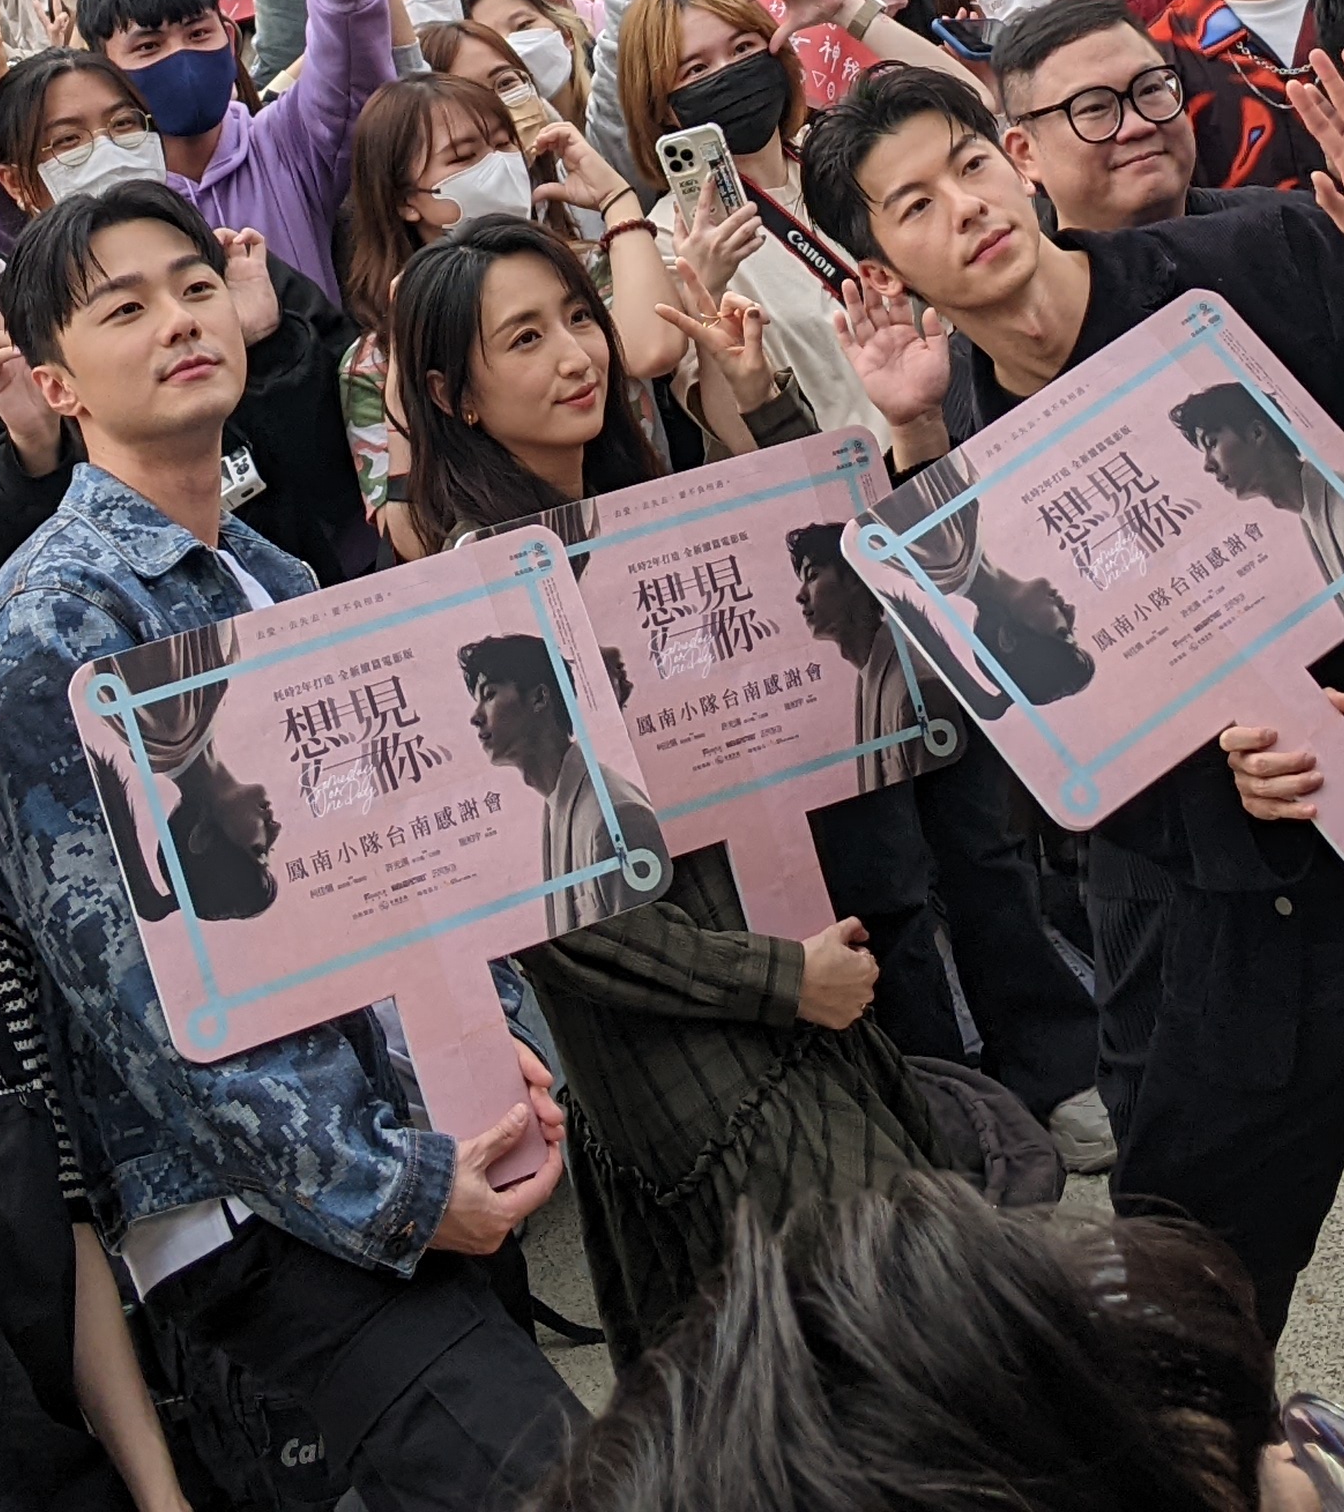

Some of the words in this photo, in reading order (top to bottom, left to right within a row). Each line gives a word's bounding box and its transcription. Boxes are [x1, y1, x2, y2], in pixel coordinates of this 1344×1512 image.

[787, 230, 836, 278] Canon
[1091, 522, 1264, 652] 鳳南小隊台南感謝會
[636, 662, 822, 736] 鳳南小隊台南感謝會
[285, 791, 503, 883] 鳳南小隊台南感謝會
